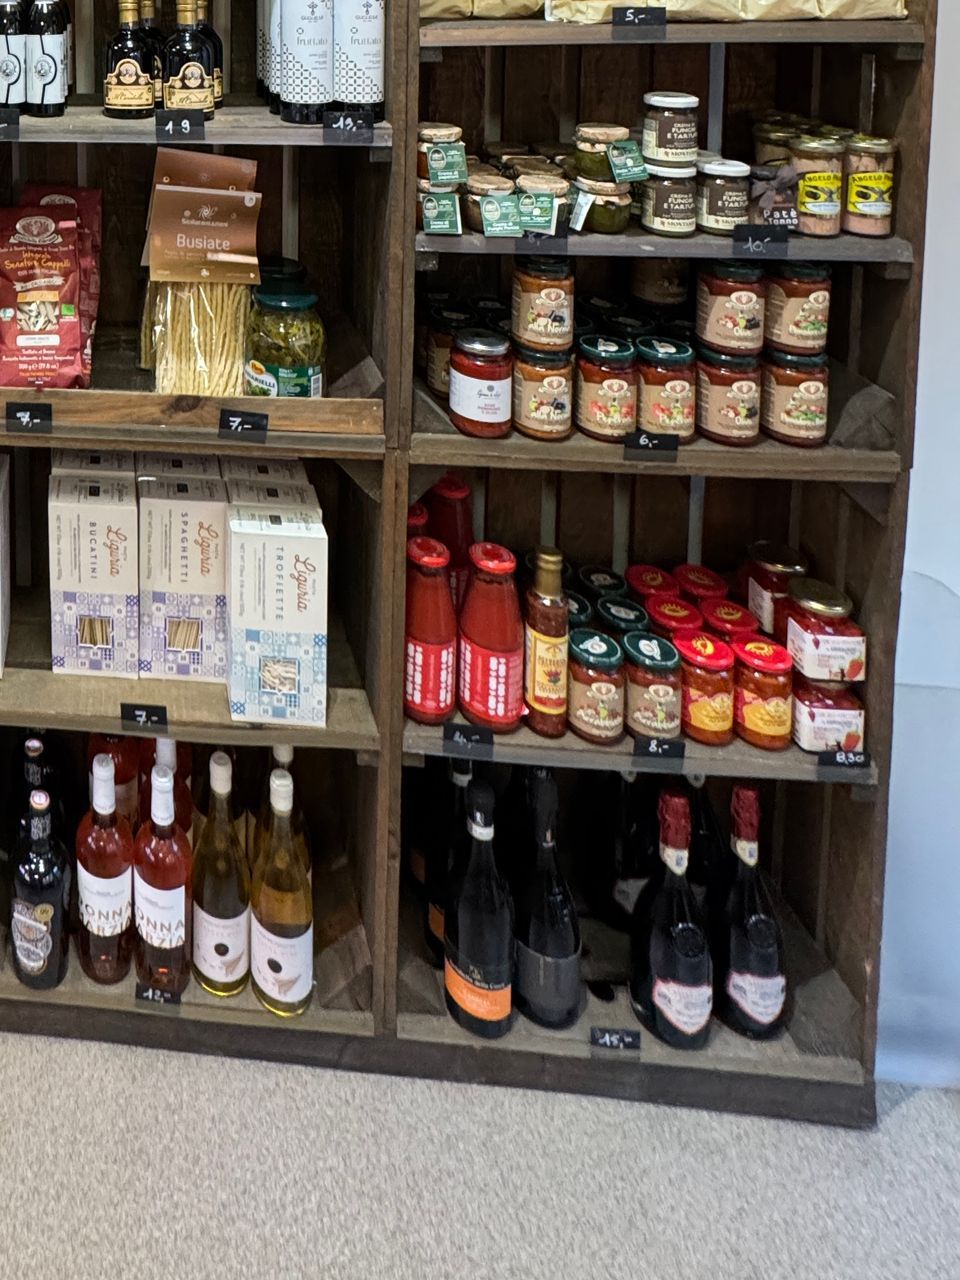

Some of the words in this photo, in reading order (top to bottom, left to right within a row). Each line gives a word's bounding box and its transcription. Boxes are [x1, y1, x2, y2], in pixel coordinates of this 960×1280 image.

[40, 257, 71, 269] Cappelli
[176, 233, 231, 251] Busiate
[89, 520, 98, 580] BUCATINI
[103, 523, 128, 578] Liguria
[180, 511, 189, 583] SPAGHETTI
[193, 520, 219, 577] Liguria
[275, 546, 284, 621] TROFIETTE
[290, 553, 316, 613] Liguria
